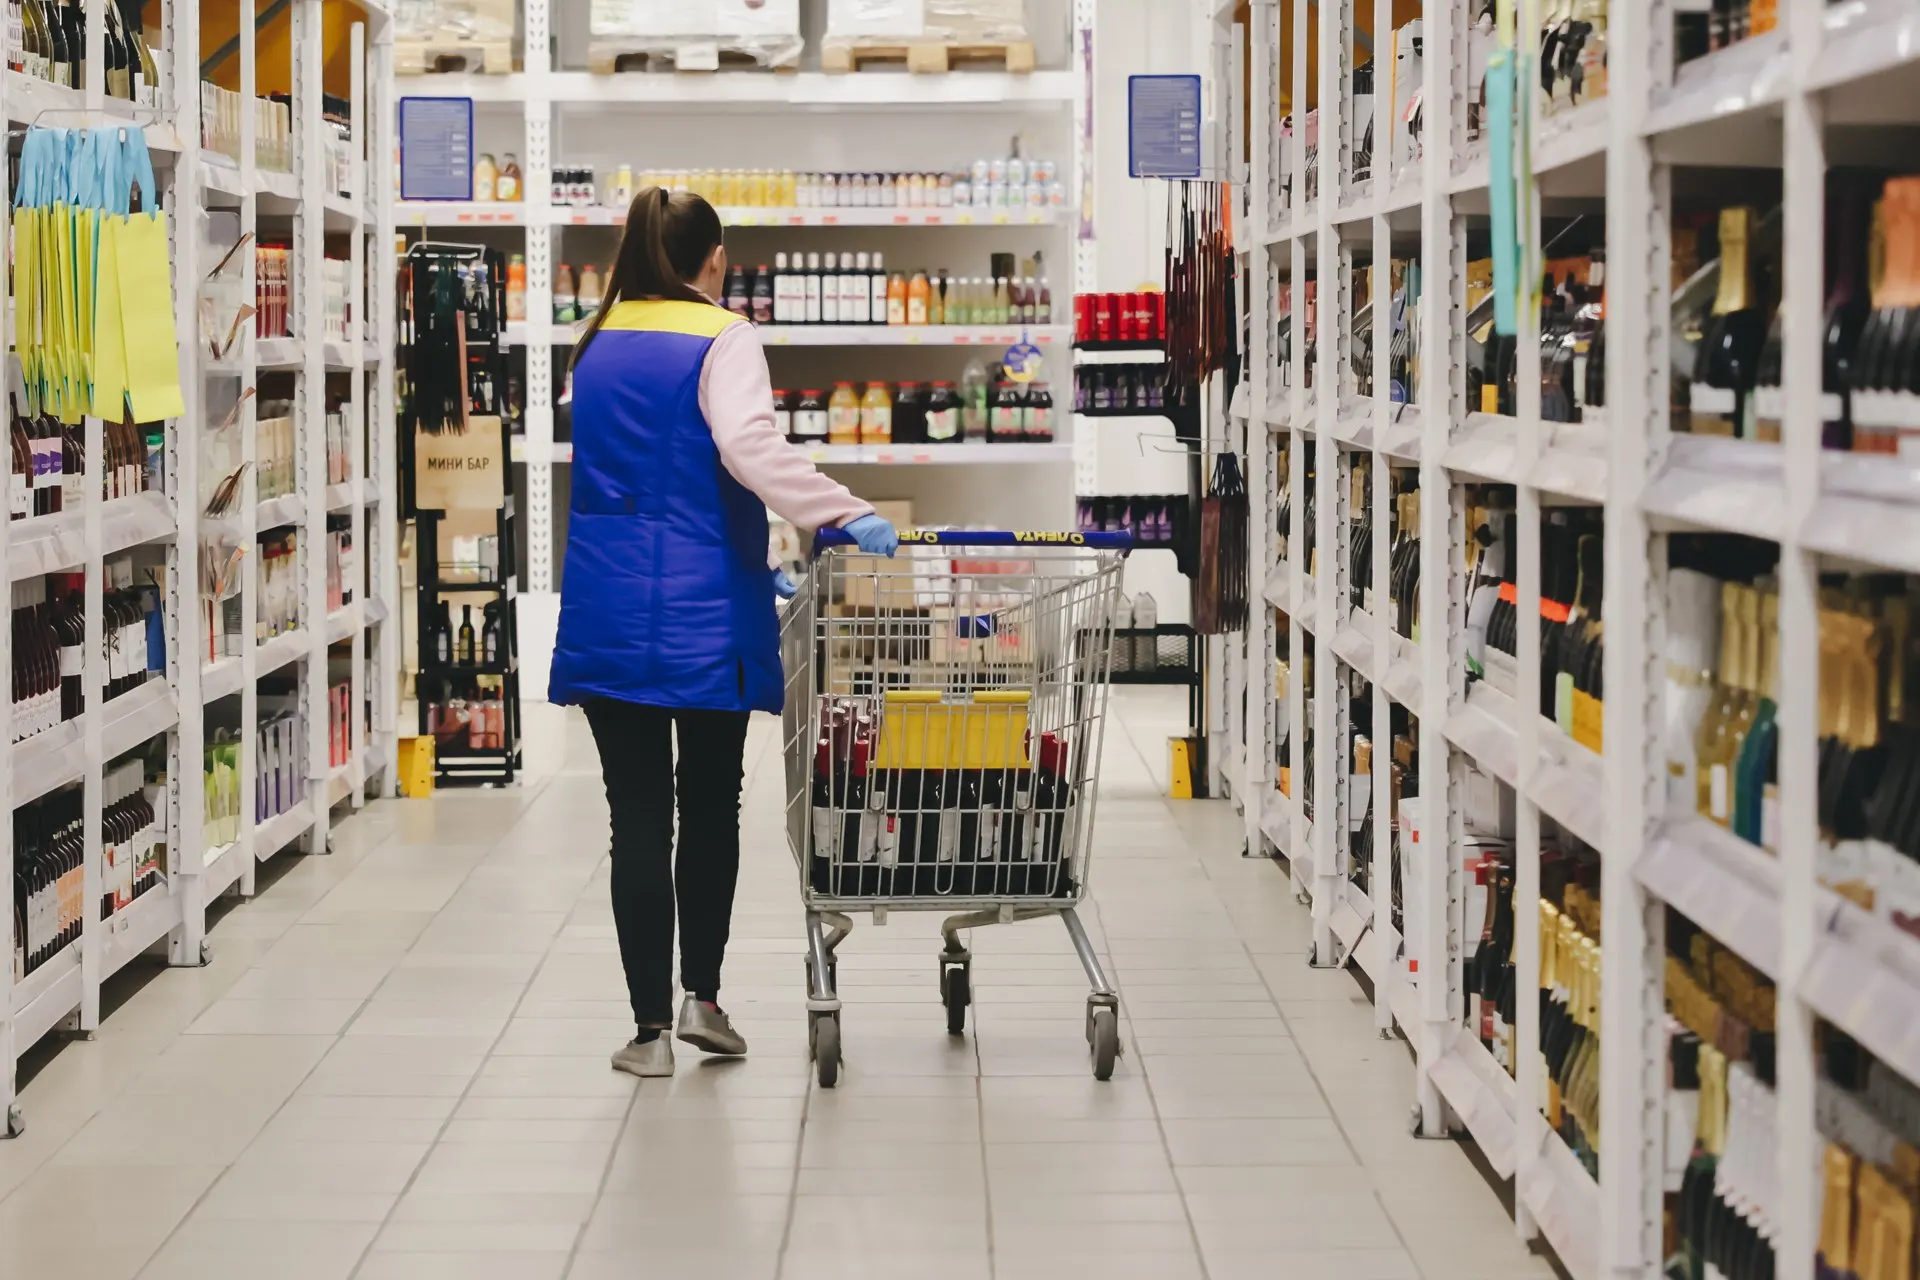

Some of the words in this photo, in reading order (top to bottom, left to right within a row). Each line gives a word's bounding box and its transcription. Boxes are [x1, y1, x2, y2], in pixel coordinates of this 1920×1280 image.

[428, 457, 463, 470] МИНИ
[467, 457, 490, 470] БАР
[1012, 531, 1069, 542] ЛЕНТА
